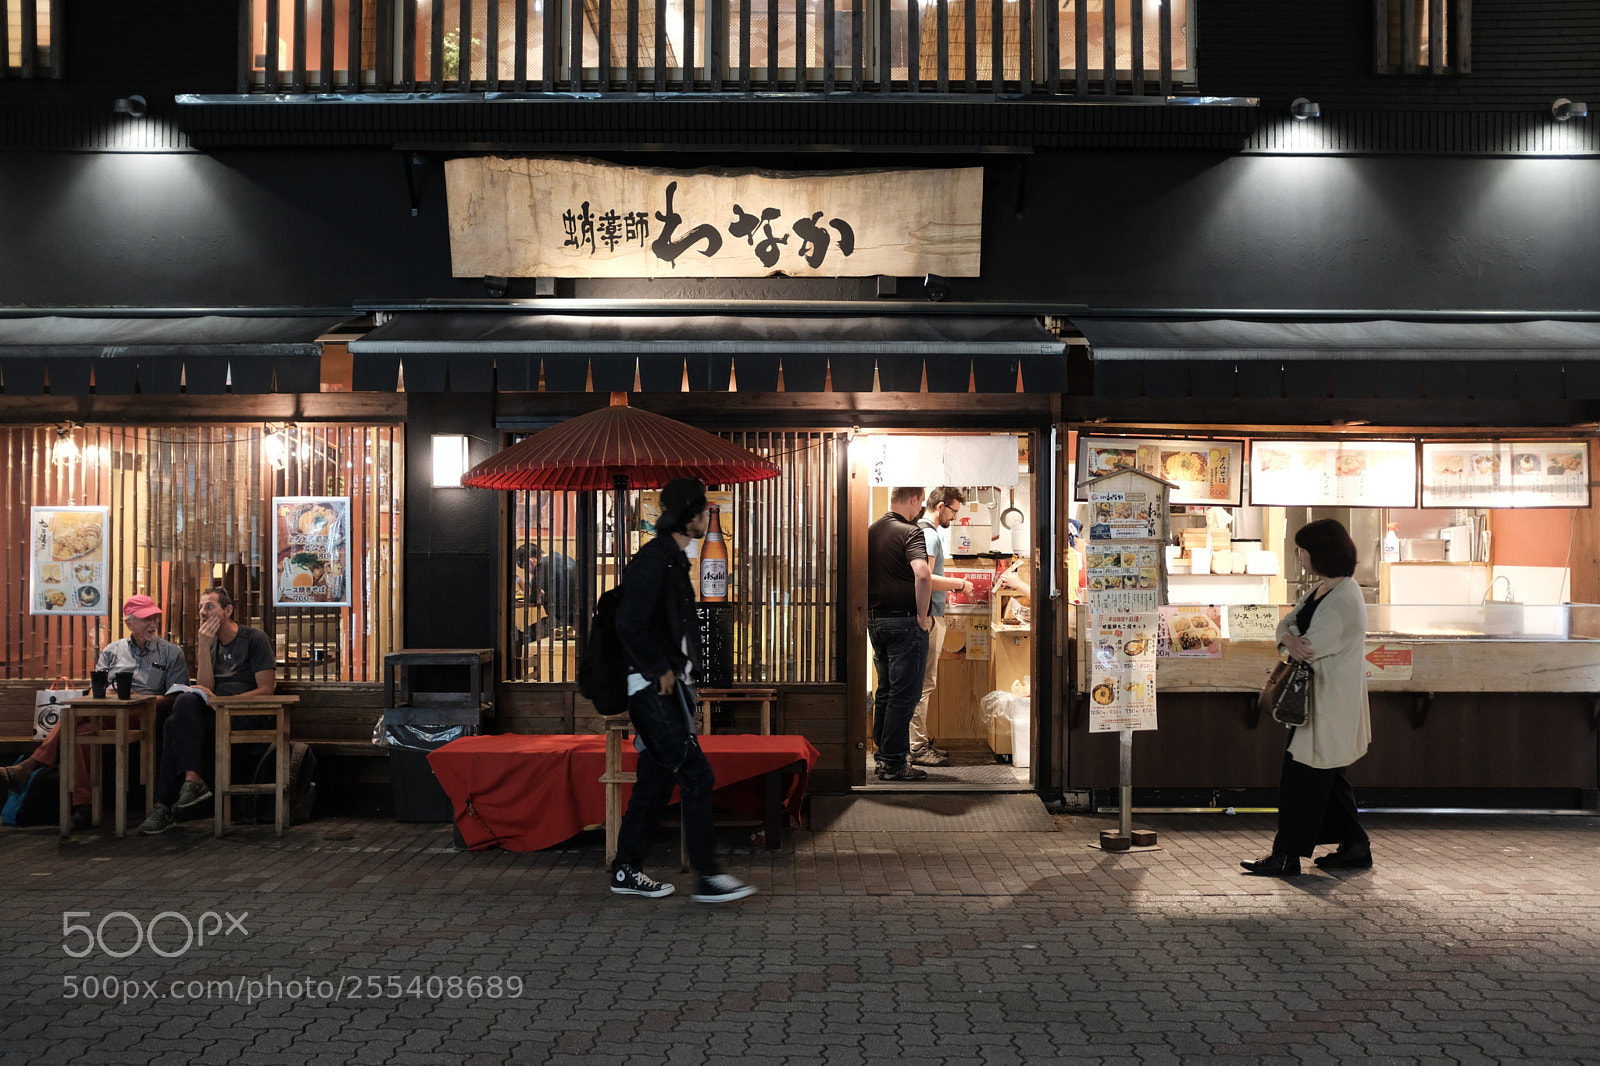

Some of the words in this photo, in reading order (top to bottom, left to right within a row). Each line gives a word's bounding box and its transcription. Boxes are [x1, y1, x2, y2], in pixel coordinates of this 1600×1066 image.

[562, 201, 650, 254] 蛸薬師
[651, 181, 855, 269] わなか
[703, 571, 725, 581] Asahi
[279, 586, 327, 594] ソース焼きそば
